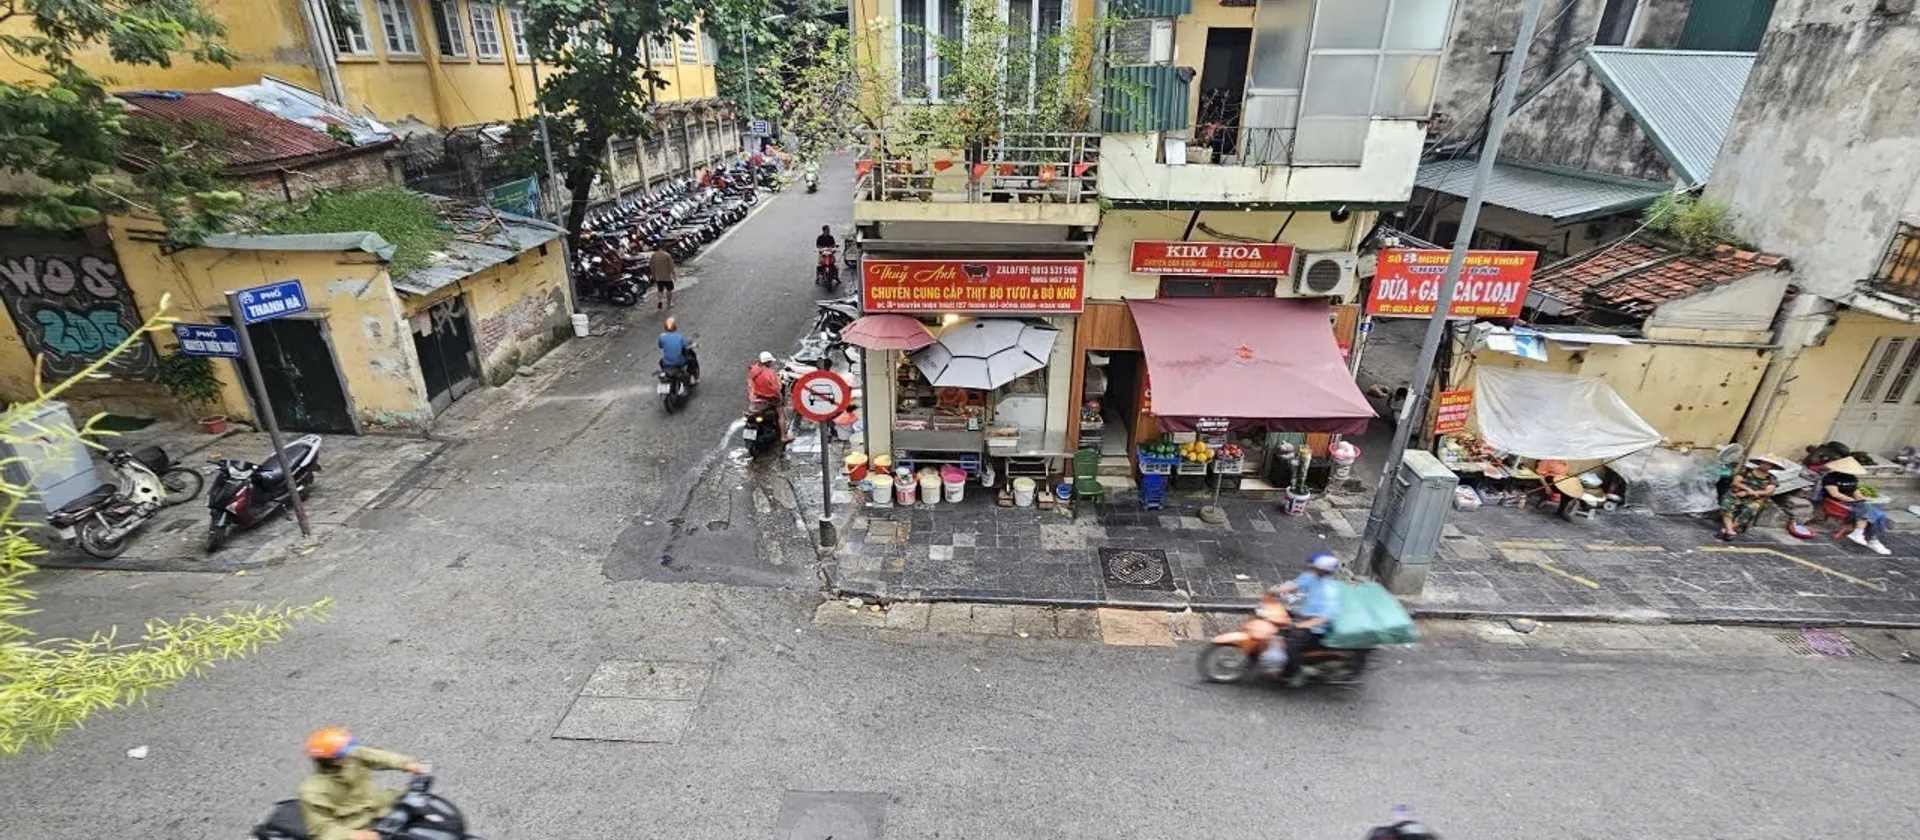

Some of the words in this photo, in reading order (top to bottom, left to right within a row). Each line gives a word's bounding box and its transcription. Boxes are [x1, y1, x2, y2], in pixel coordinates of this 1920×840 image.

[1165, 245, 1208, 258] KIM
[1218, 246, 1262, 259] HOA
[914, 264, 957, 282] Anh
[260, 288, 282, 300] PHỐ
[913, 286, 941, 299] CUNG
[966, 286, 987, 301] THỊT
[1032, 289, 1040, 299] &
[1452, 275, 1484, 301] CÁC
[248, 299, 285, 318] THANH
[285, 294, 301, 309] HÀ
